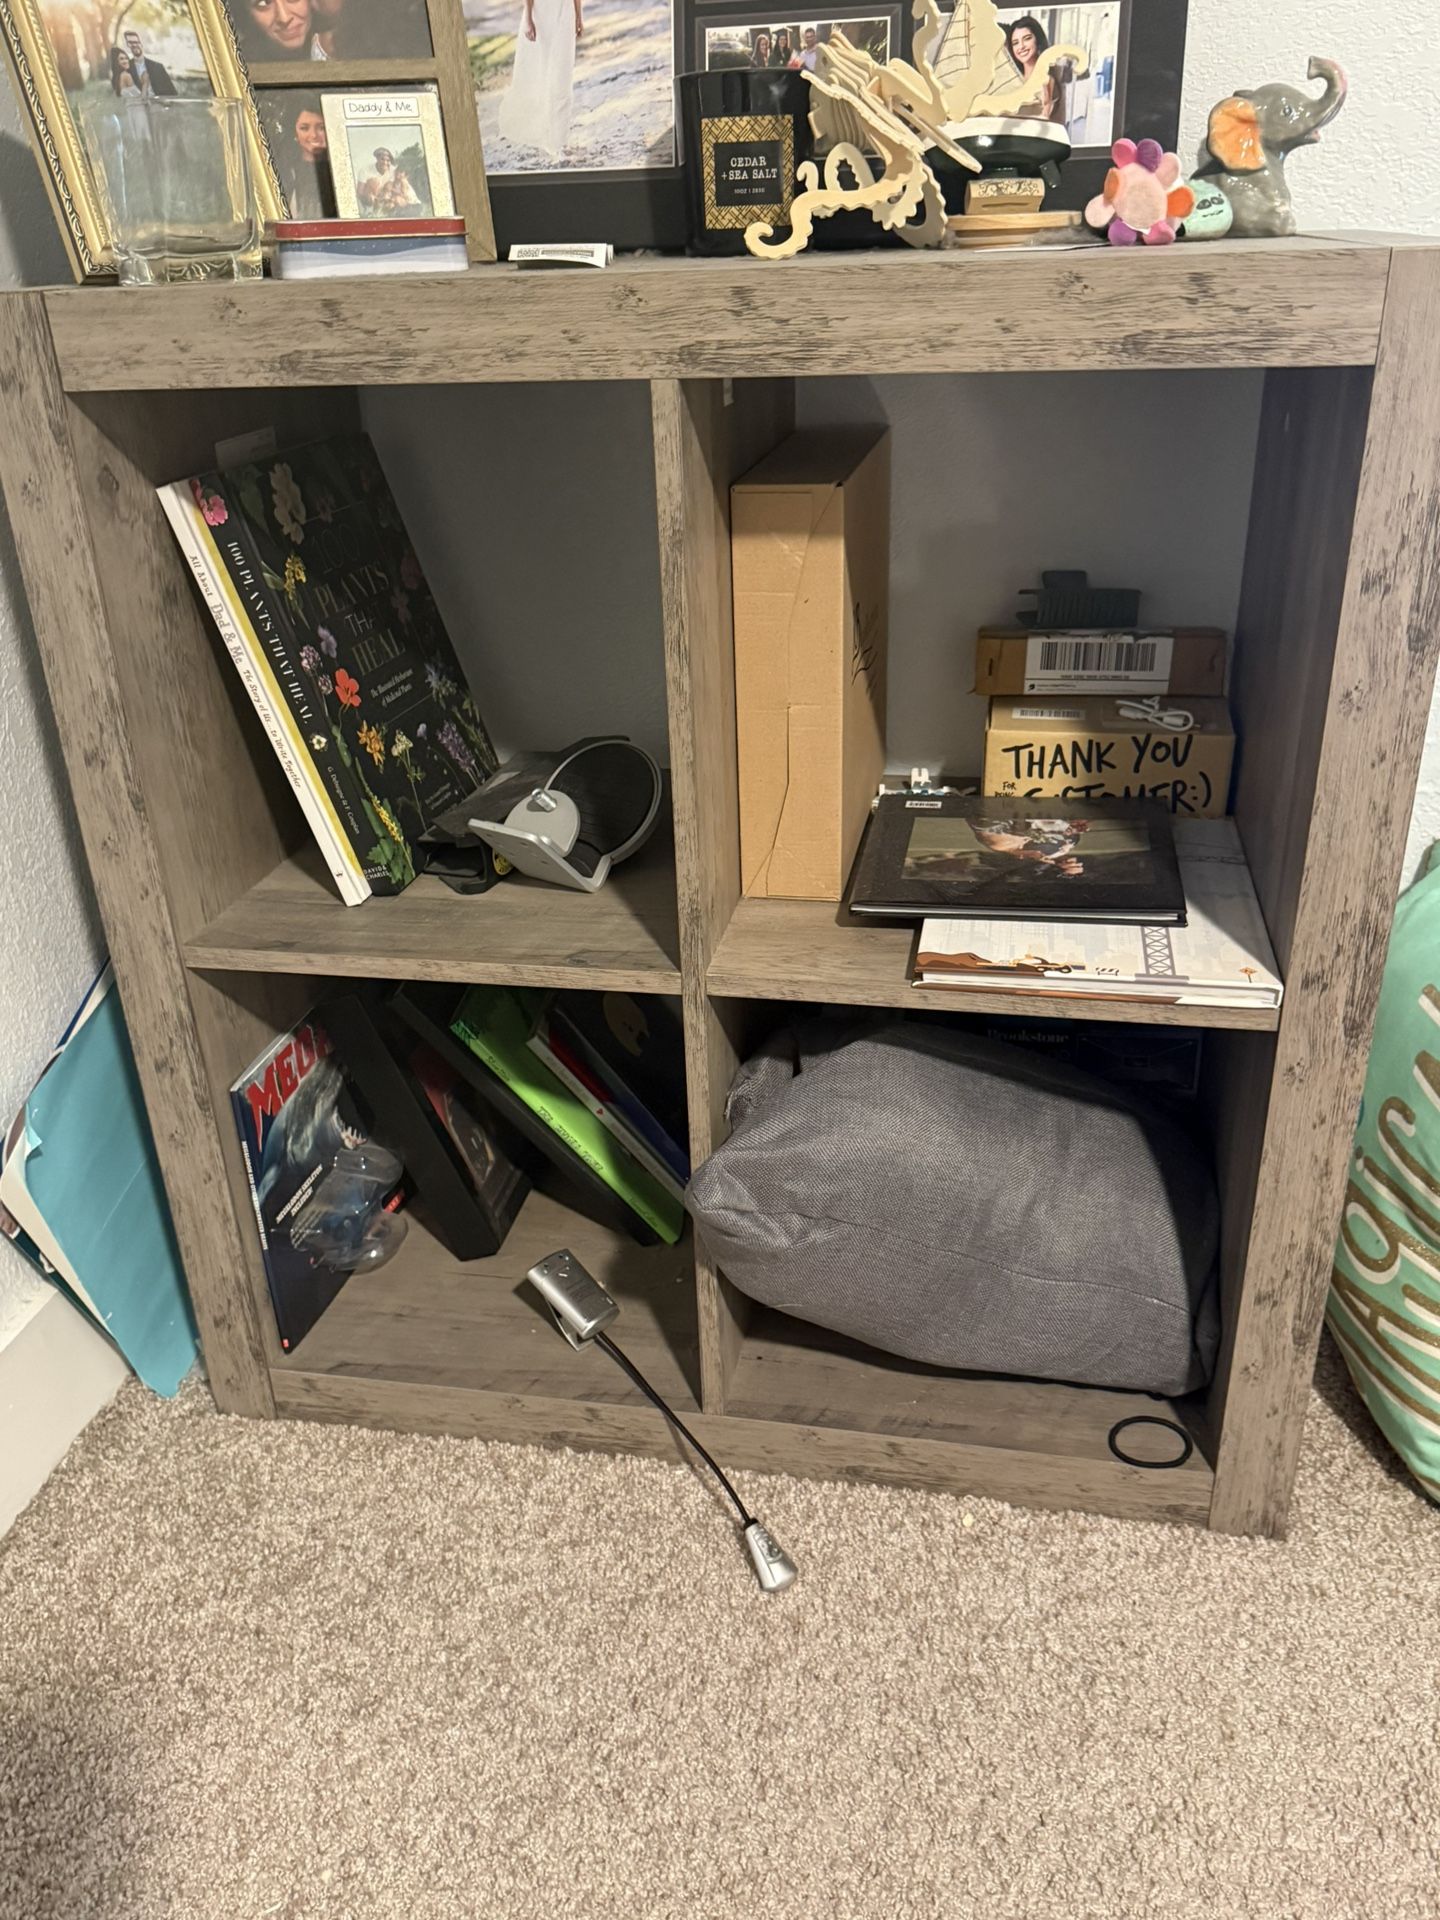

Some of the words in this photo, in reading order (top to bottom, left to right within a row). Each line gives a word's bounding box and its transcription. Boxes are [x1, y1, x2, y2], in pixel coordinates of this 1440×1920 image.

[348, 103, 382, 116] Daddy
[385, 101, 392, 112] &
[395, 101, 412, 112] Me
[730, 156, 767, 167] CEDAR
[752, 168, 778, 179] SALT
[314, 563, 391, 620] PLANTS
[211, 603, 231, 629] Dad
[223, 632, 236, 643] &
[230, 645, 244, 665] Me
[243, 669, 252, 682] The
[249, 684, 262, 703] Story
[228, 542, 245, 566] 100
[240, 570, 274, 632] PLANTS
[269, 634, 296, 677] THAT
[288, 682, 312, 724] HEAL
[352, 627, 406, 676] HEAL
[1001, 739, 1117, 780] THANK
[1131, 733, 1193, 774] YOU
[1002, 781, 1016, 790] FOR
